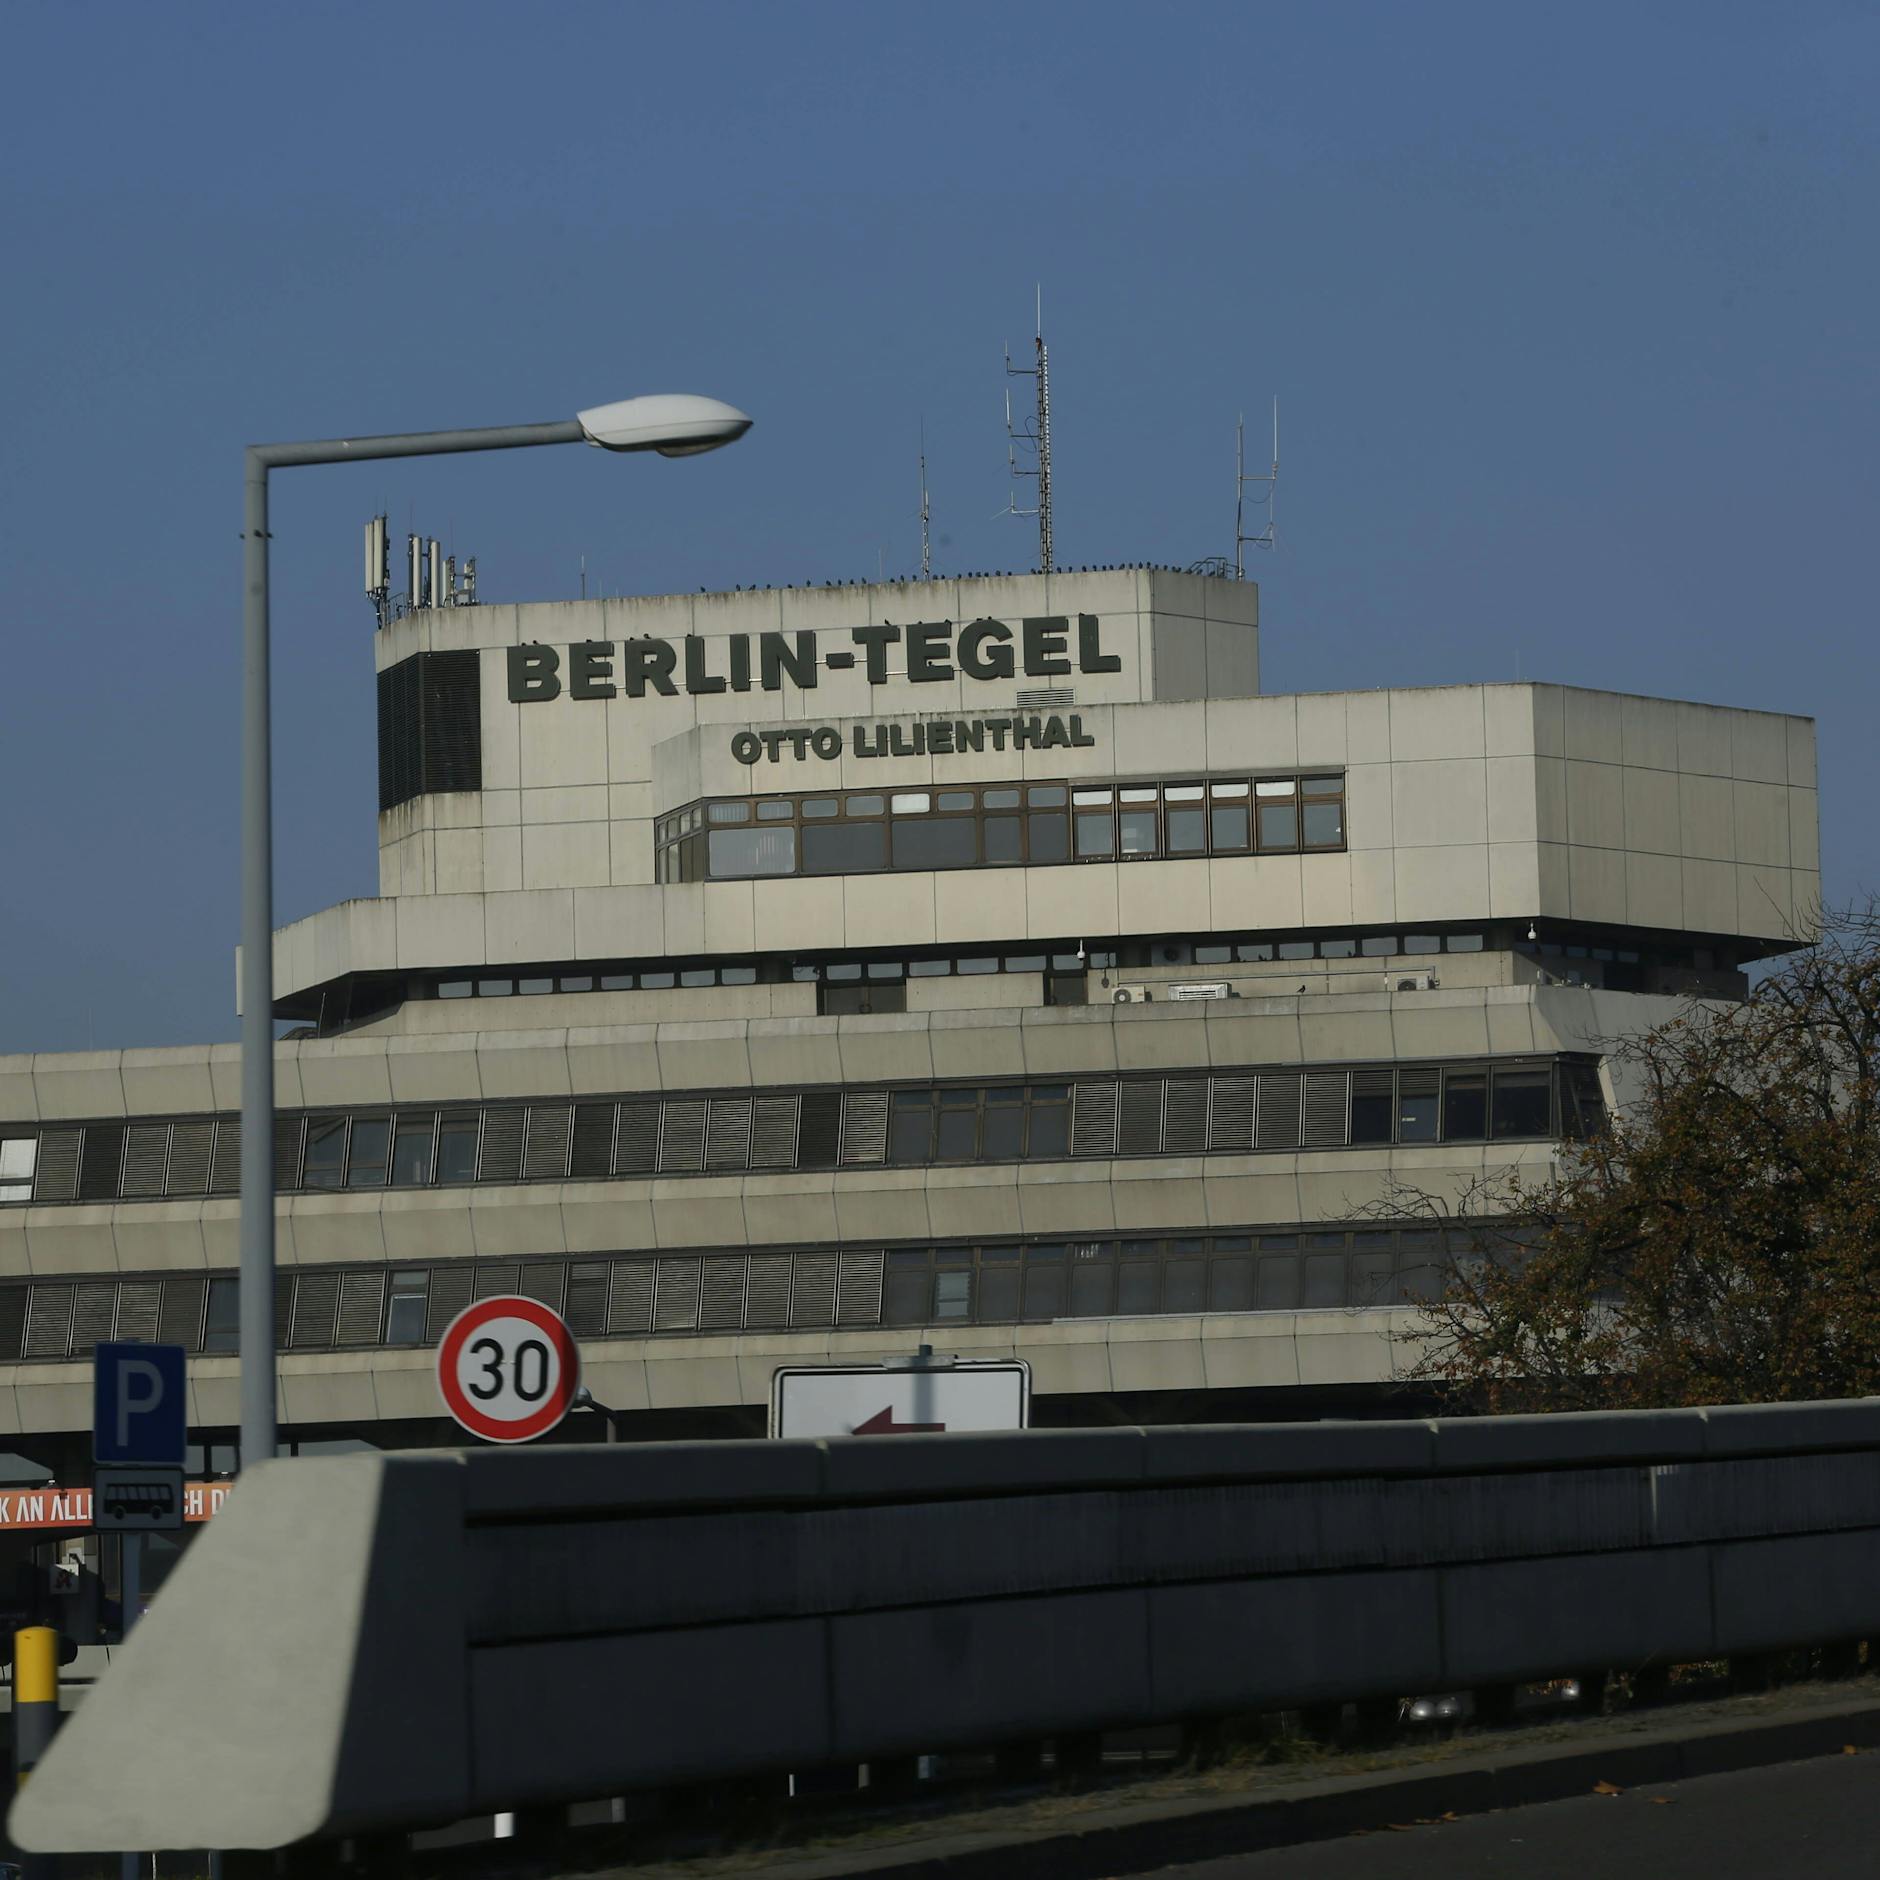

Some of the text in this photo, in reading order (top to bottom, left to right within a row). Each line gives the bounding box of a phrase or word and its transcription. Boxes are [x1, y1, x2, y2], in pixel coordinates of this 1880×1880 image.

[507, 614, 1121, 703] BERLIN-TEGEL
[731, 715, 1095, 765] OTTO LILIENTHAL
[468, 1337, 549, 1402] 30
[116, 1359, 165, 1447] P
[16, 1495, 44, 1522] AN
